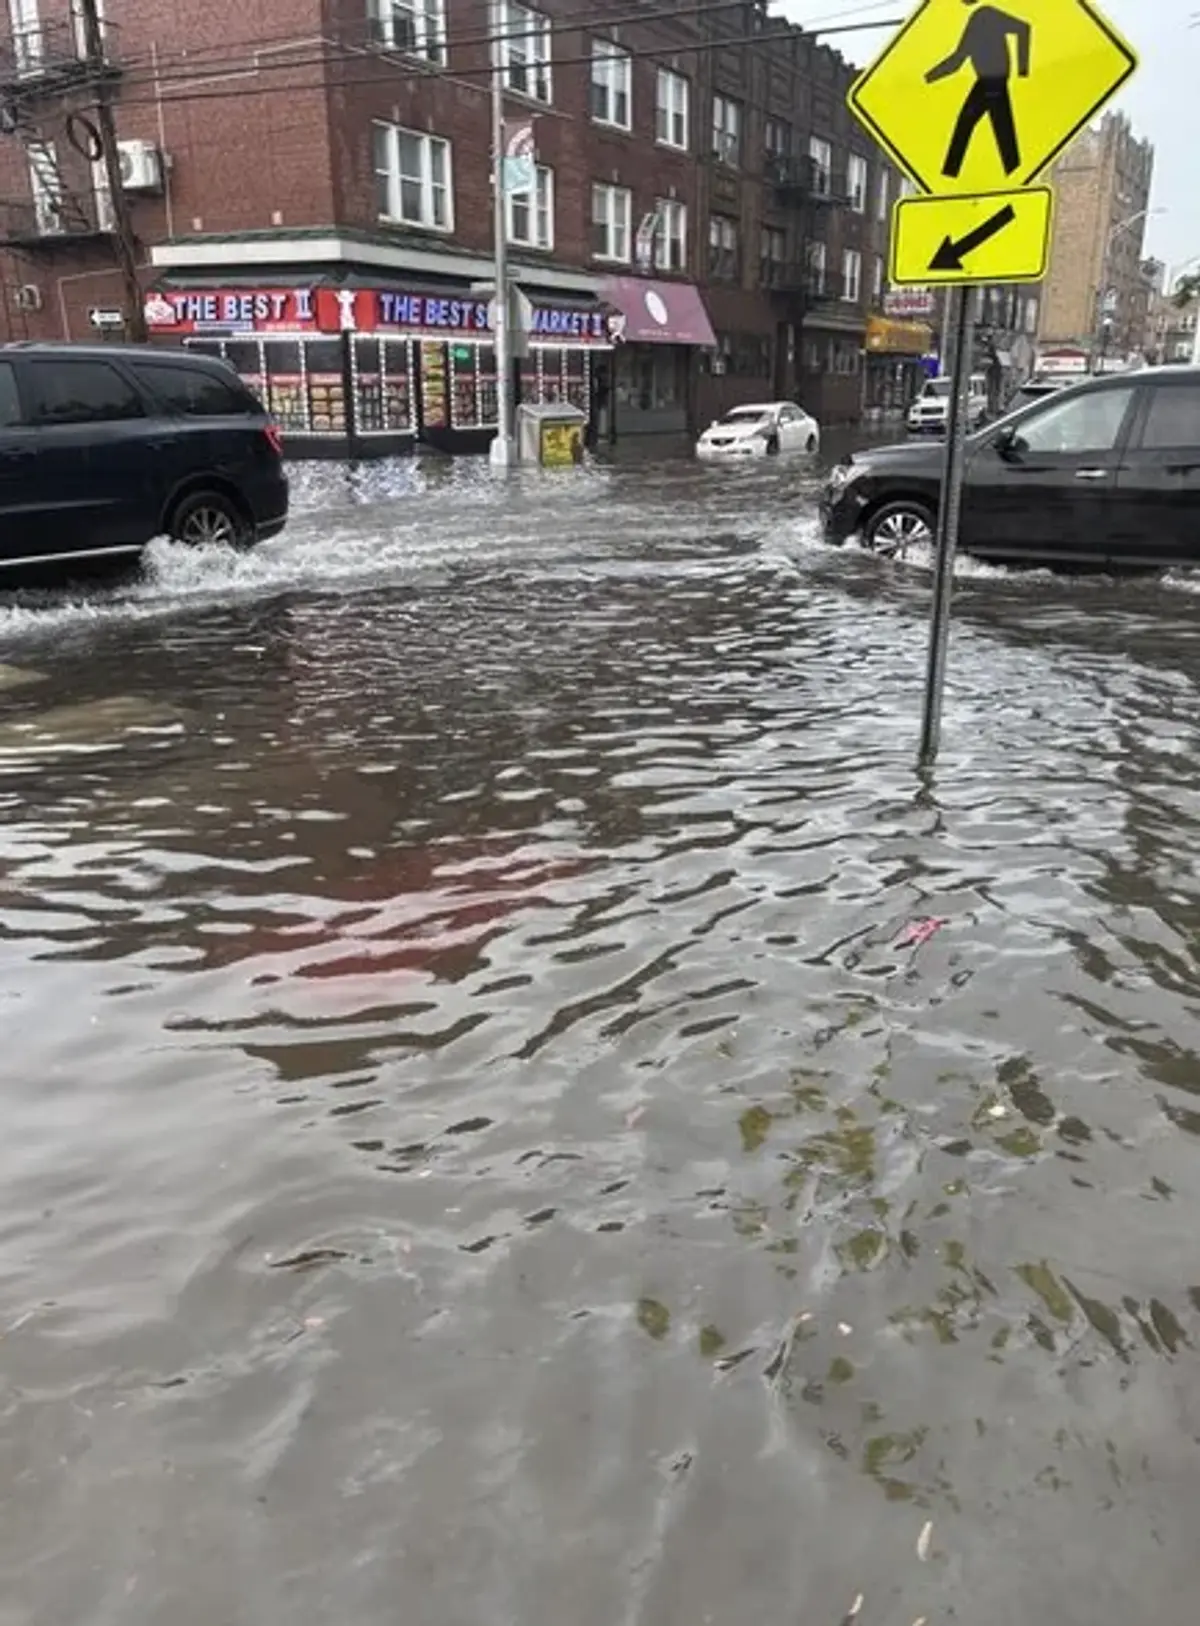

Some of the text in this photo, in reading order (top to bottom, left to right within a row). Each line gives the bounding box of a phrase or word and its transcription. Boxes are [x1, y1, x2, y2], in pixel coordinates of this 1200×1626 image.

[173, 289, 313, 320] THE BEST II
[381, 293, 421, 324] THE
[425, 298, 473, 328] BEST
